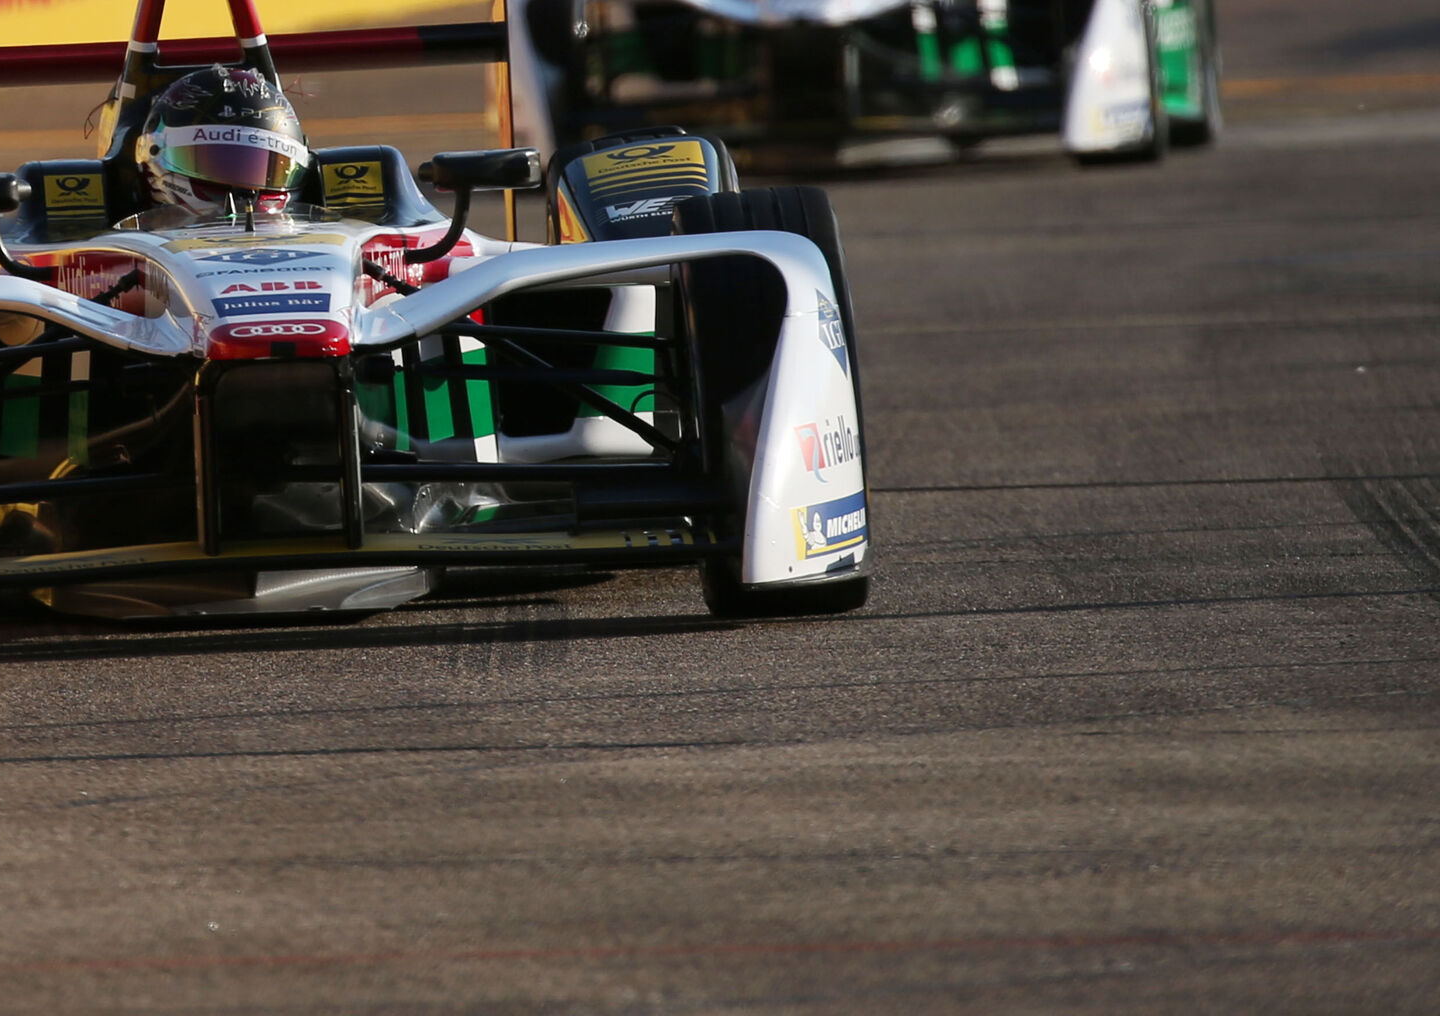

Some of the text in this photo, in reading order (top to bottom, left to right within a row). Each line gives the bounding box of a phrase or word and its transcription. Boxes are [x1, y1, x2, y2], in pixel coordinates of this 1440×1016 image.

[193, 128, 297, 155] Audi e-tron
[216, 266, 336, 275] FANBOOST
[221, 281, 323, 294] ABB
[224, 301, 280, 311] Julius
[823, 416, 854, 468] riello
